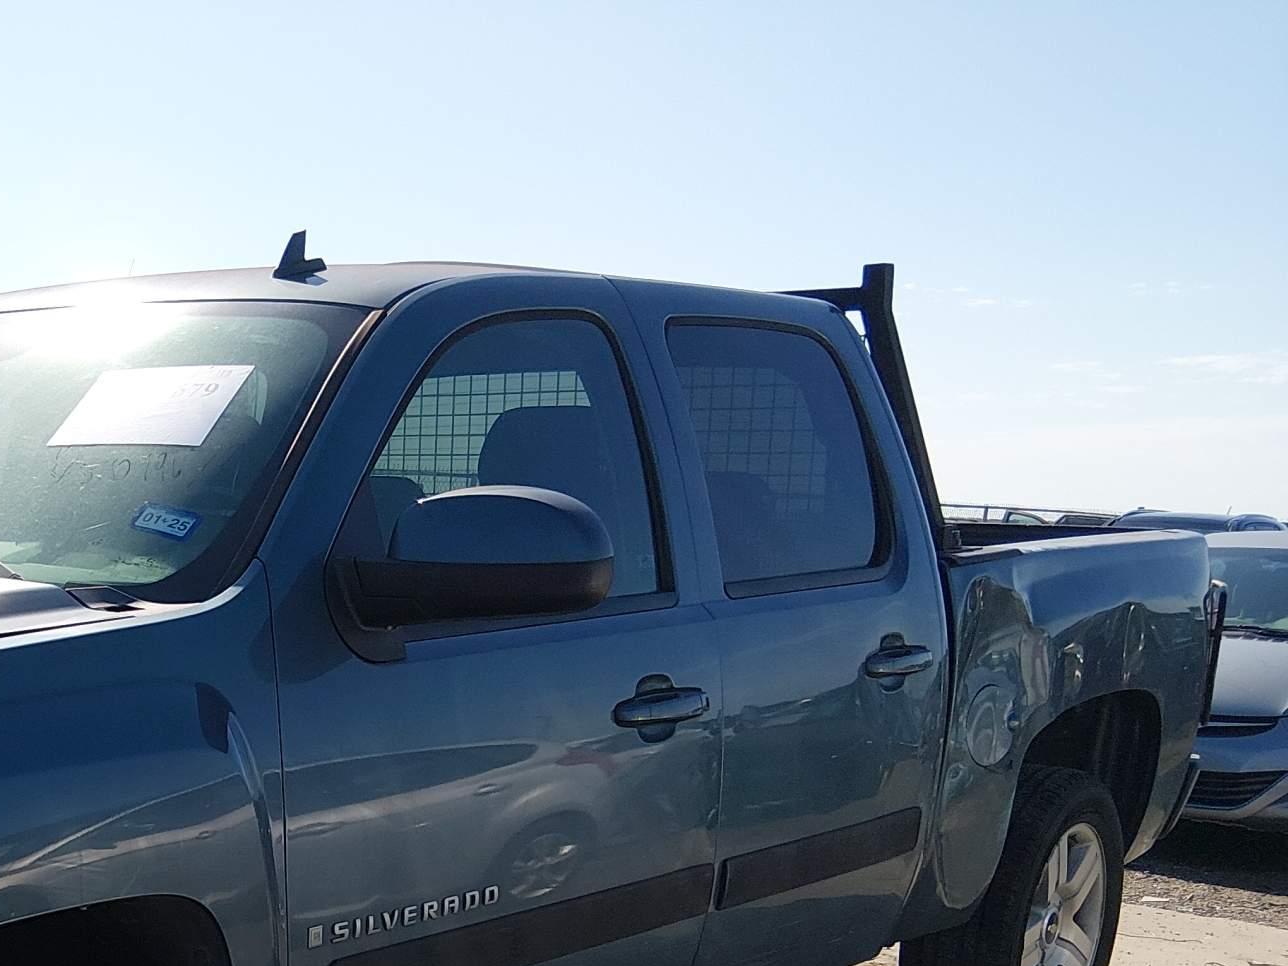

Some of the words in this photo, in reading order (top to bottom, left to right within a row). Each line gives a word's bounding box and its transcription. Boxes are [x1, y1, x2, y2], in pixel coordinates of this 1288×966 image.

[142, 512, 162, 524] 01
[167, 518, 190, 531] 25
[331, 885, 500, 942] SILVERADO
